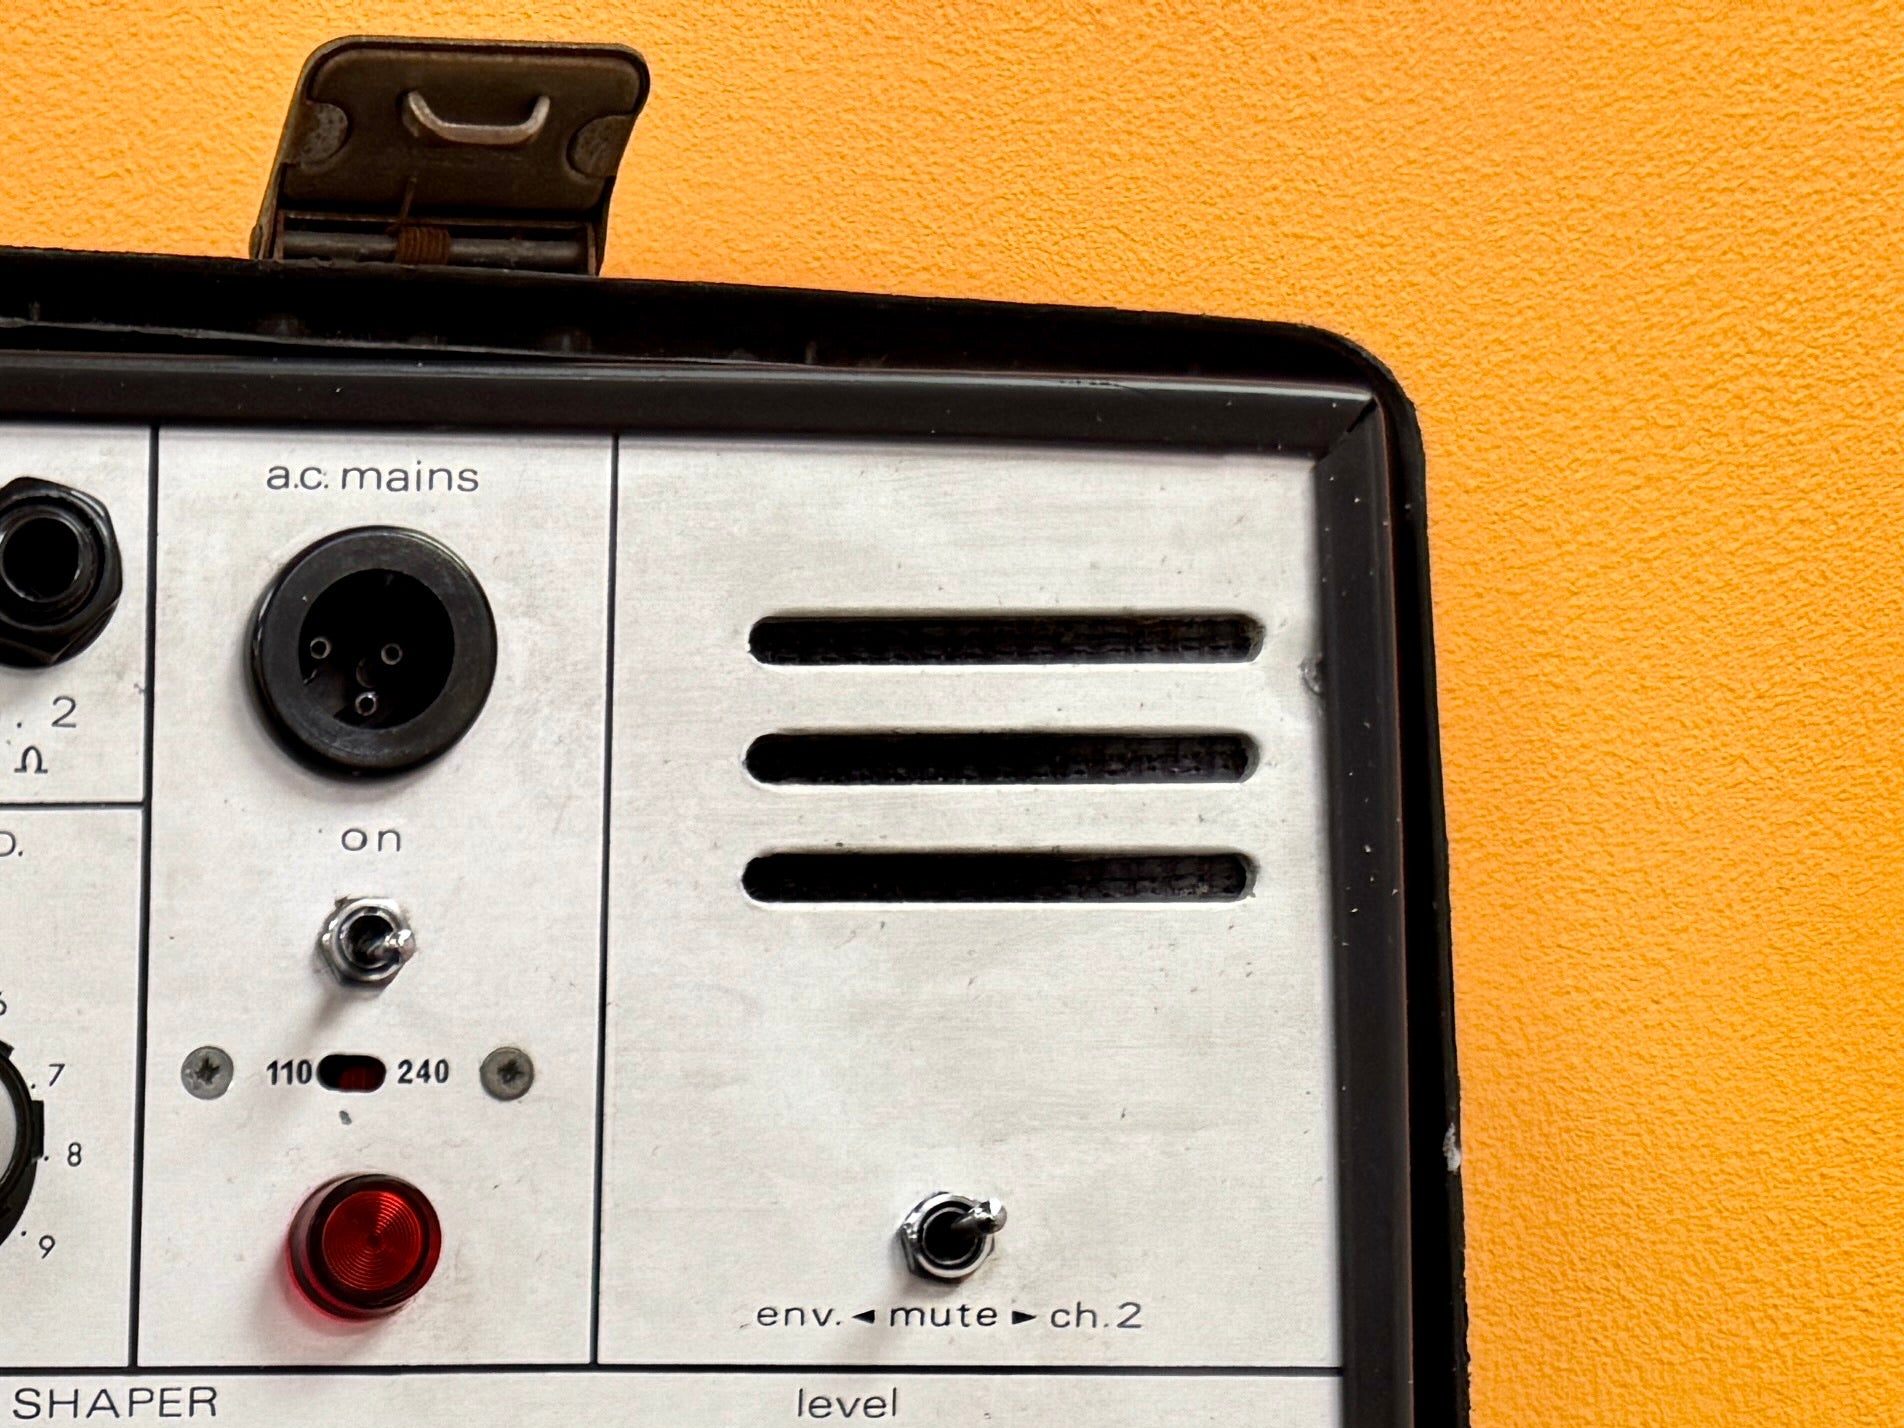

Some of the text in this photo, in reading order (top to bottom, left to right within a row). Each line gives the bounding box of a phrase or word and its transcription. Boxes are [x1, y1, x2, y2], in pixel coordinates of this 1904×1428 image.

[341, 827, 402, 852] on
[266, 1058, 450, 1086] 110 240
[756, 1300, 1142, 1329] env. mute ch.2
[12, 1385, 218, 1420] SHAPER
[797, 1386, 898, 1419] level
